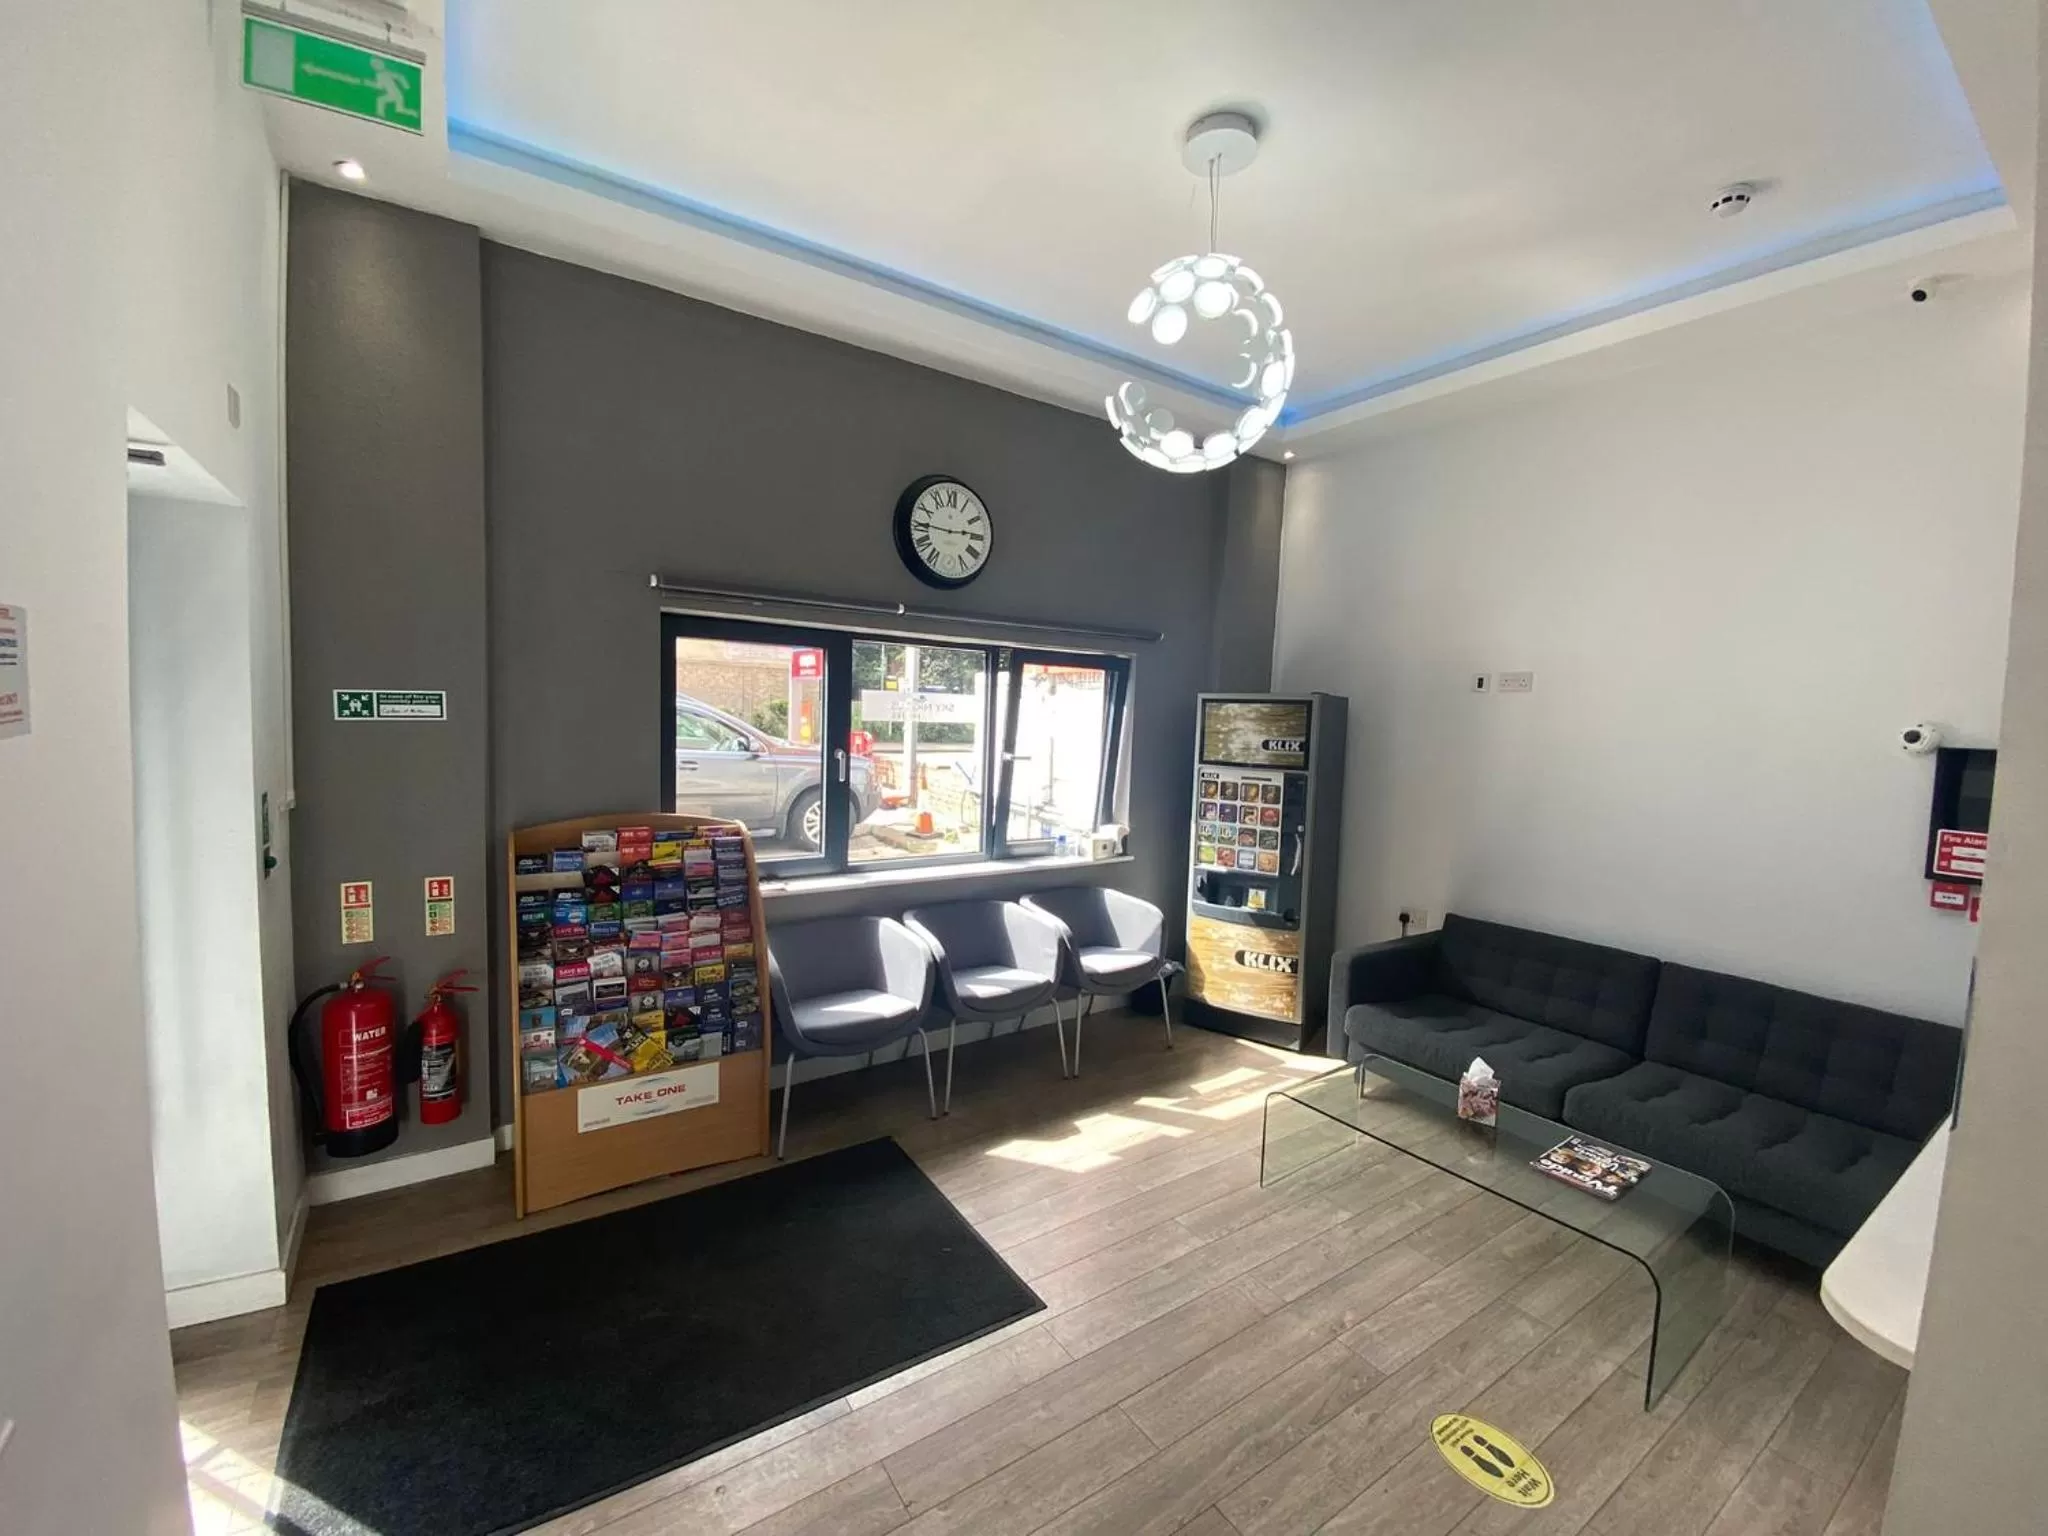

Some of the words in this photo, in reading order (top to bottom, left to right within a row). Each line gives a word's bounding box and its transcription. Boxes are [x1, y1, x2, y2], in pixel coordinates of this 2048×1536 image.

[1268, 740, 1301, 751] KLIX
[1243, 951, 1292, 973] KLIX
[354, 1026, 386, 1042] WATER
[615, 1090, 653, 1106] TAKE
[656, 1083, 687, 1099] ONE
[1506, 1468, 1531, 1488] Here
[1517, 1477, 1543, 1498] Wait
